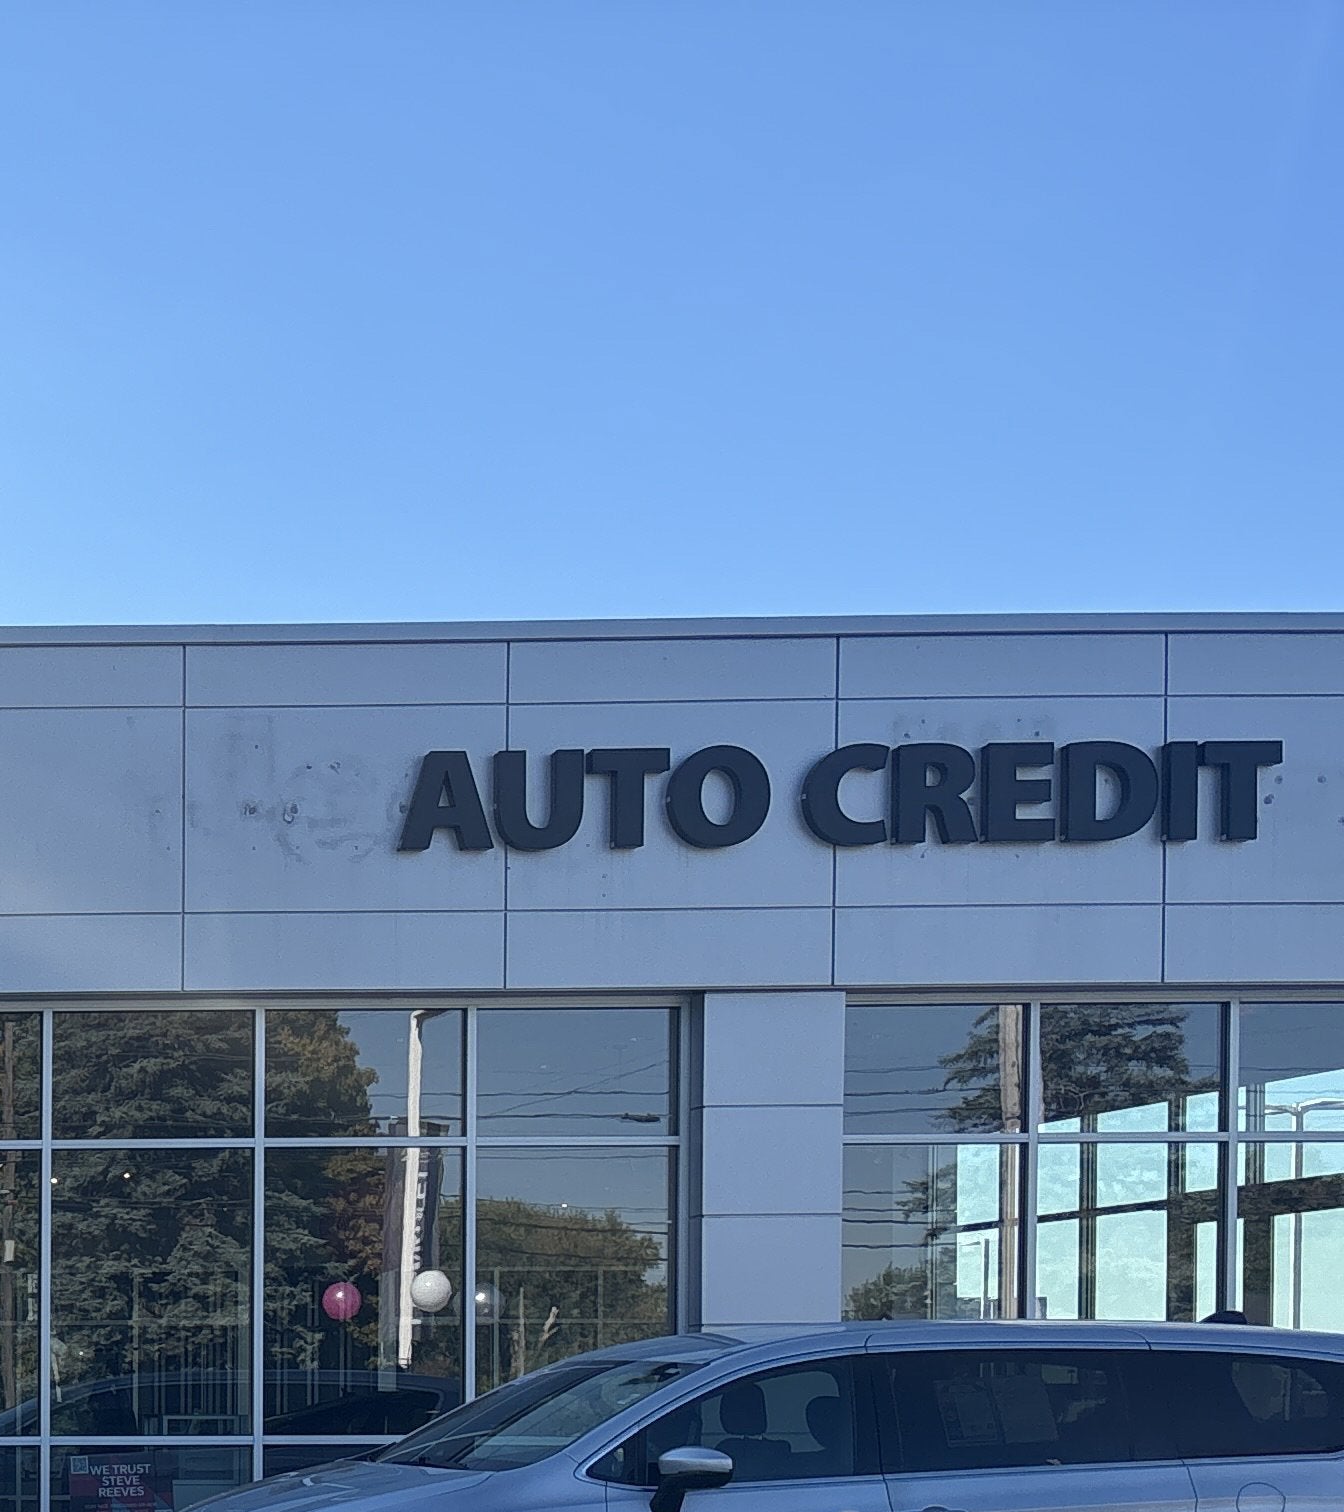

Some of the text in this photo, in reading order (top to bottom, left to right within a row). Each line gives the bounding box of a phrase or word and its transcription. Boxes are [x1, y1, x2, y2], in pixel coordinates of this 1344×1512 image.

[396, 740, 1284, 853] AUTO CREDIT
[90, 1463, 151, 1475] WE TRUST
[102, 1475, 140, 1486] STEVE
[98, 1486, 144, 1497] REEVES
